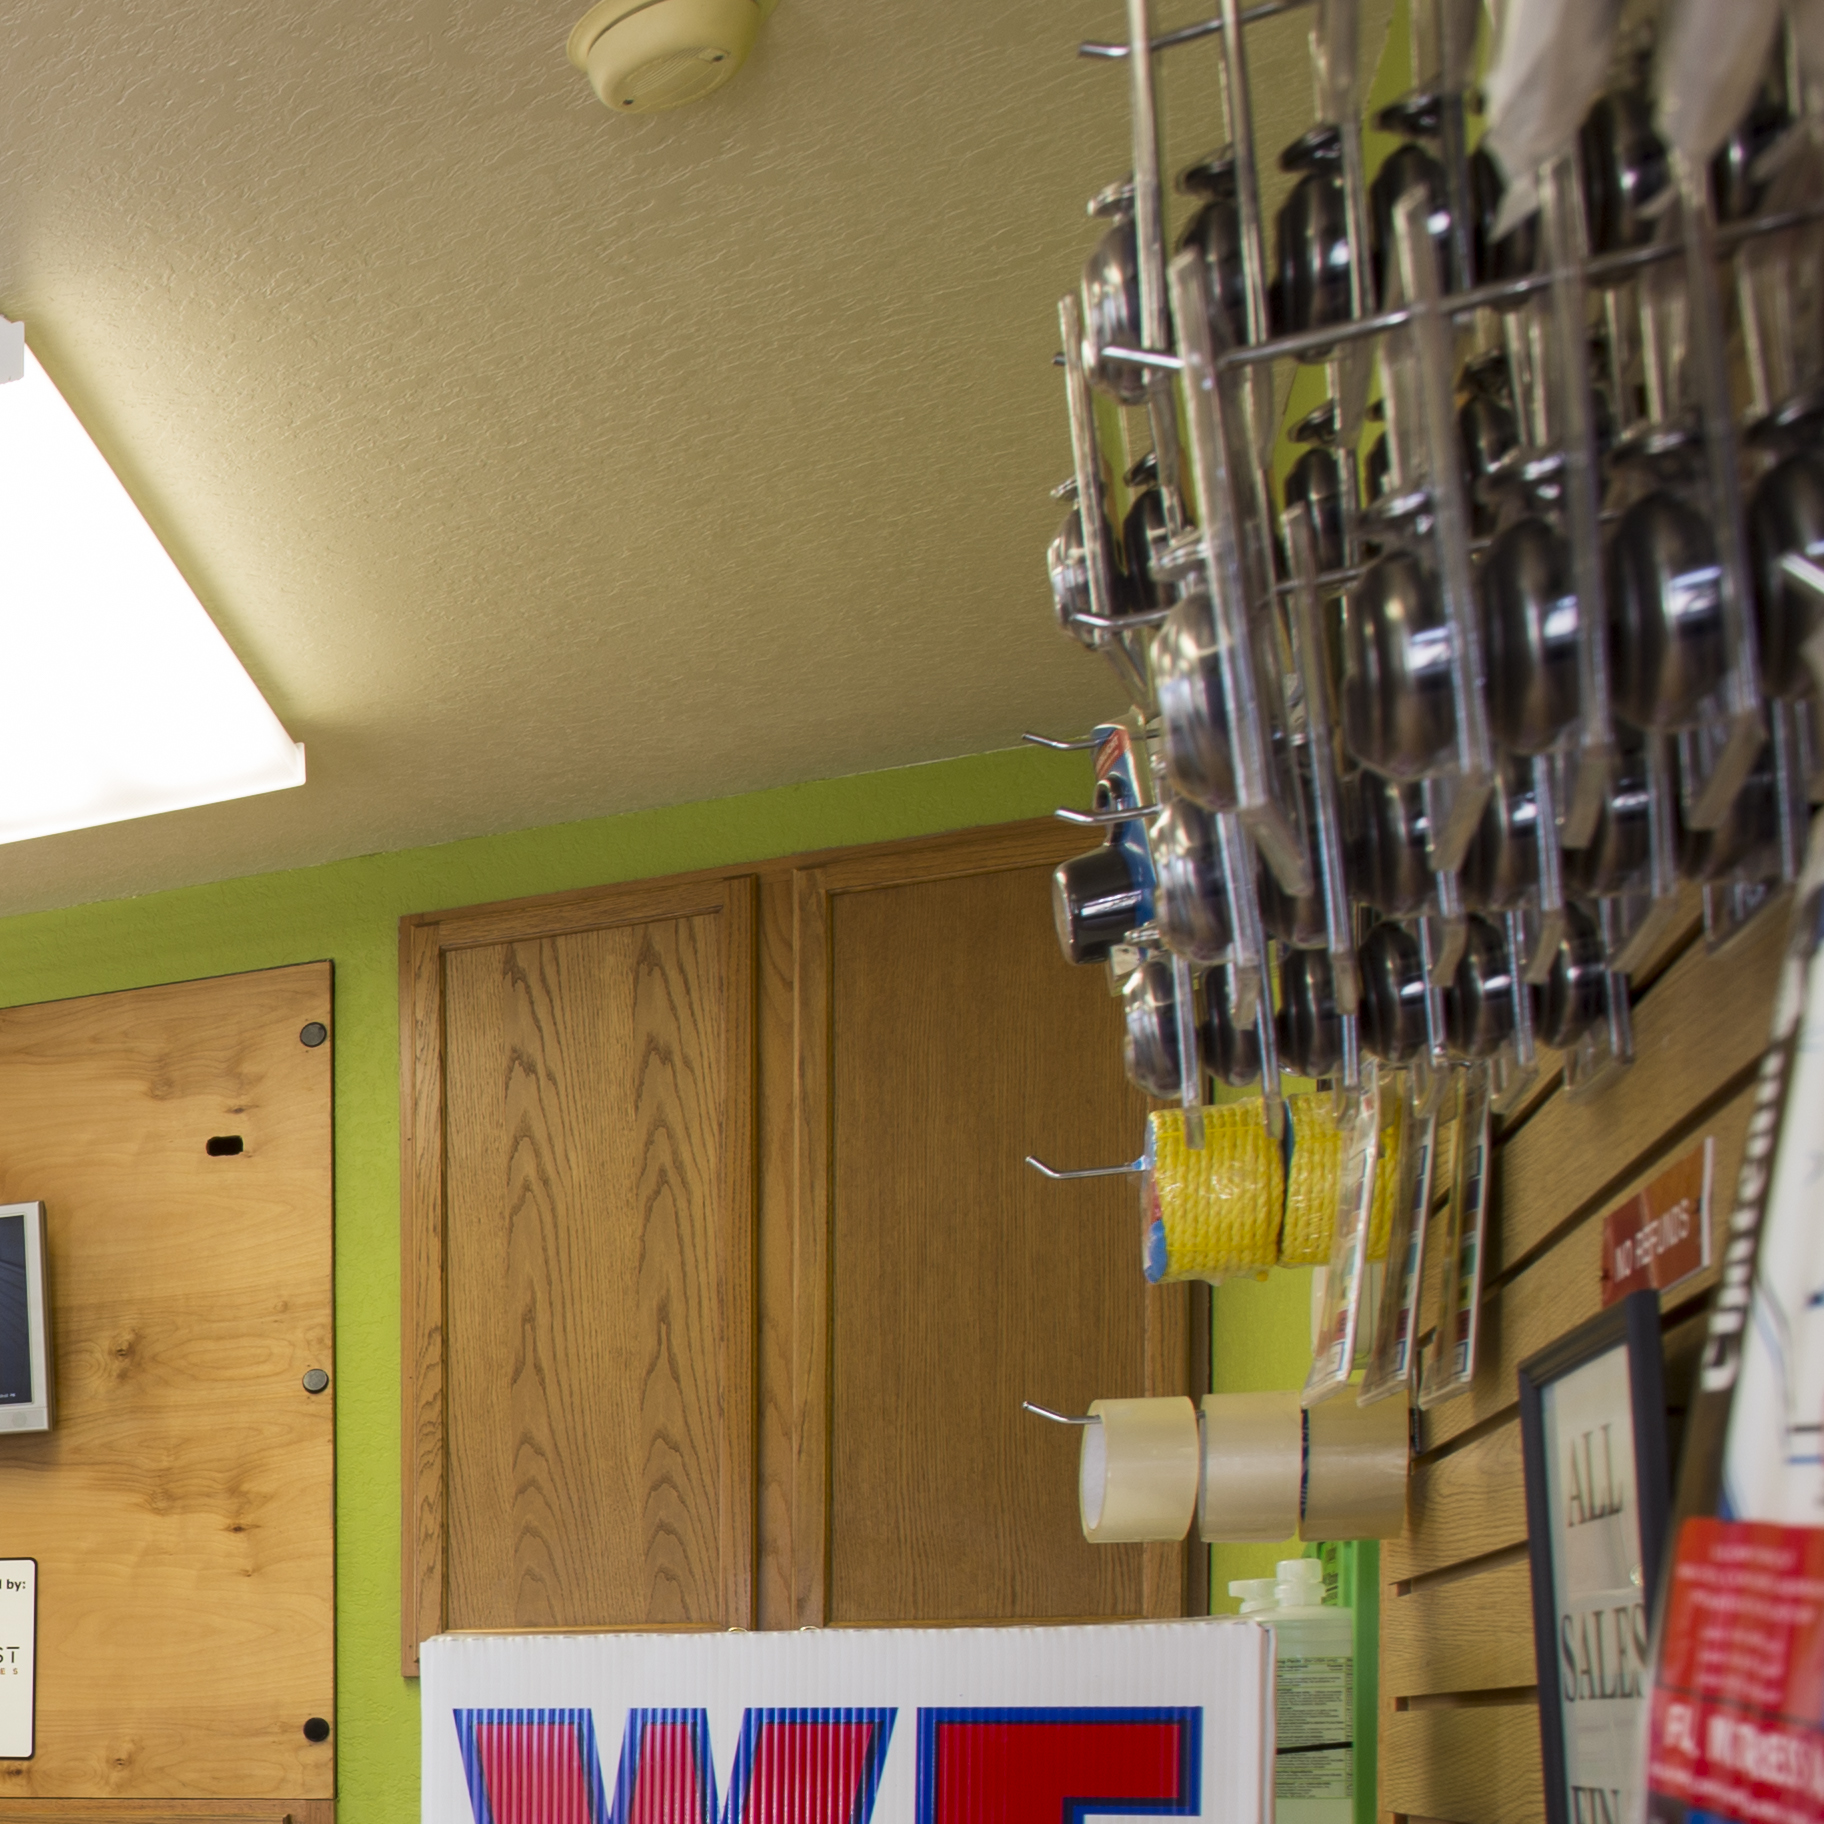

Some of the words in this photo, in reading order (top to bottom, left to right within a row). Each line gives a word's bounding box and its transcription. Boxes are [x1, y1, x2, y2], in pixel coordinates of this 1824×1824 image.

[1566, 1423, 1623, 1528] ALL
[6, 1579, 26, 1591] by:
[1561, 1602, 1648, 1702] SALES
